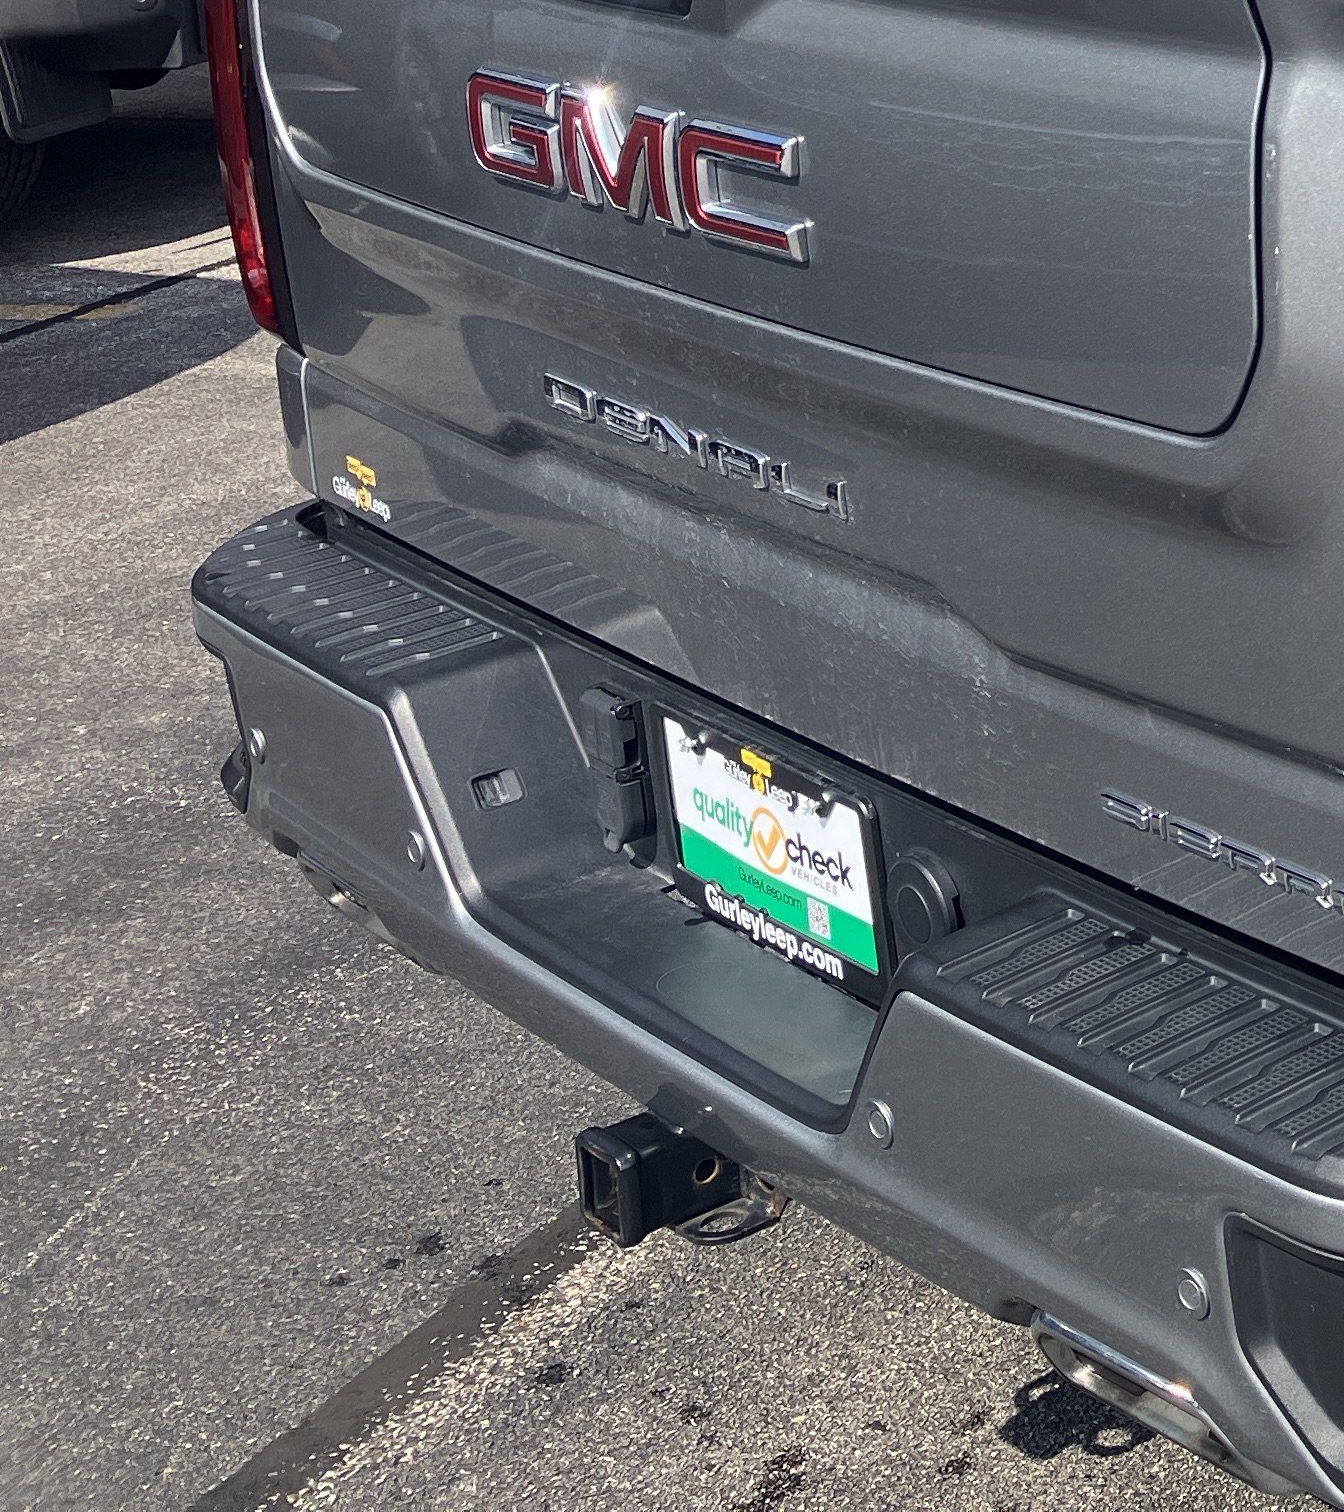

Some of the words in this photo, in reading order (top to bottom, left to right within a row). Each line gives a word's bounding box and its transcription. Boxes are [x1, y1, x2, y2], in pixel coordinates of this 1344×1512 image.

[465, 66, 813, 265] GMC
[542, 370, 851, 522] DENALI
[692, 787, 754, 848] quality
[784, 831, 854, 892] check
[738, 865, 803, 912] GurleyLeep.com
[790, 866, 839, 897] VEHICLES
[704, 882, 845, 981] Gurleyleep.com
